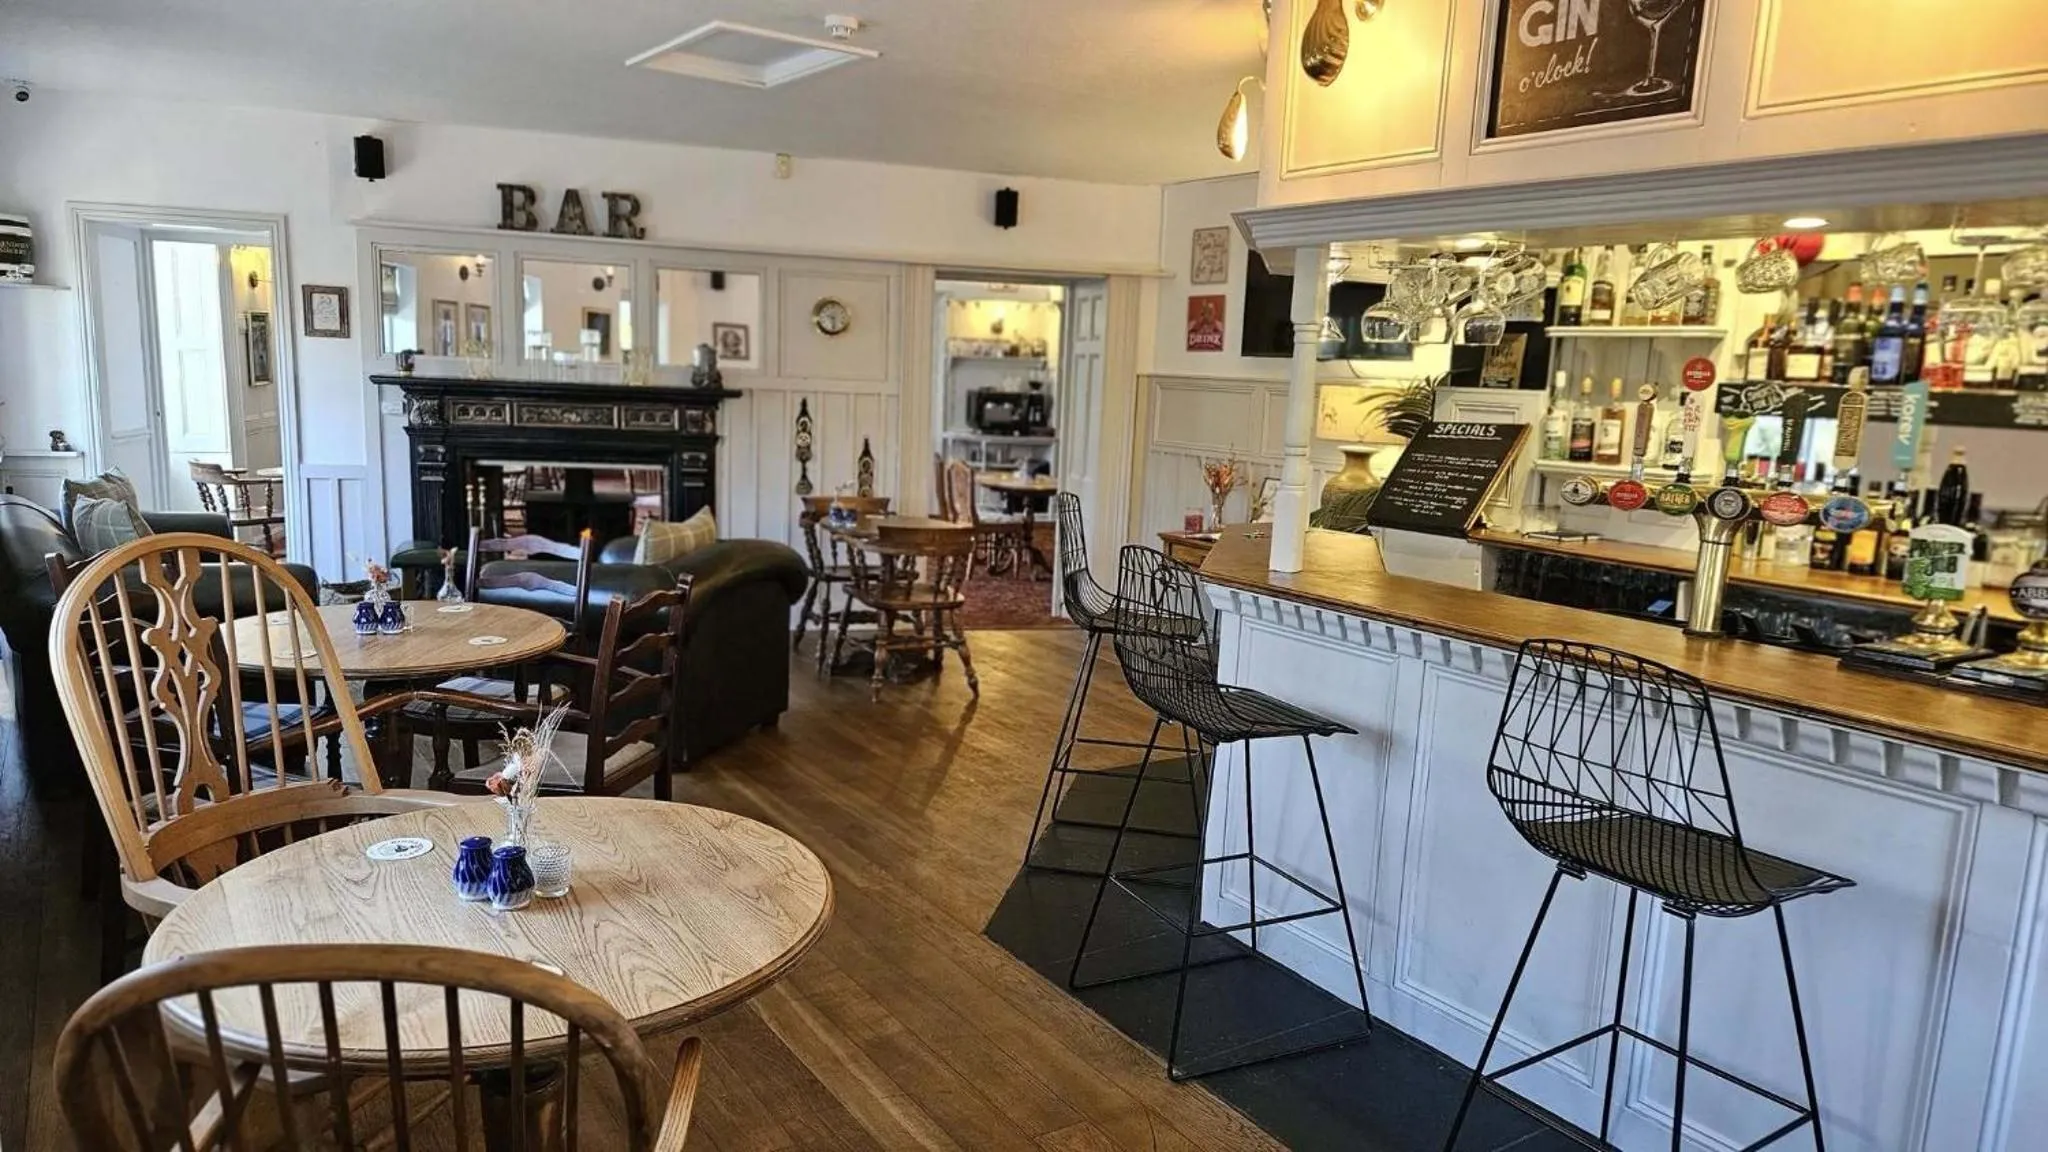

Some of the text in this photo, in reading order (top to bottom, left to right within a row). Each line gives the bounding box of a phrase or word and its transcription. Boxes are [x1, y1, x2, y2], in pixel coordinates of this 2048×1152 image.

[1518, 0, 1600, 48] GIN
[1519, 36, 1598, 93] o'clock!
[496, 183, 646, 240] BAR
[1434, 423, 1497, 437] SPECIALS
[1896, 393, 1923, 446] korev
